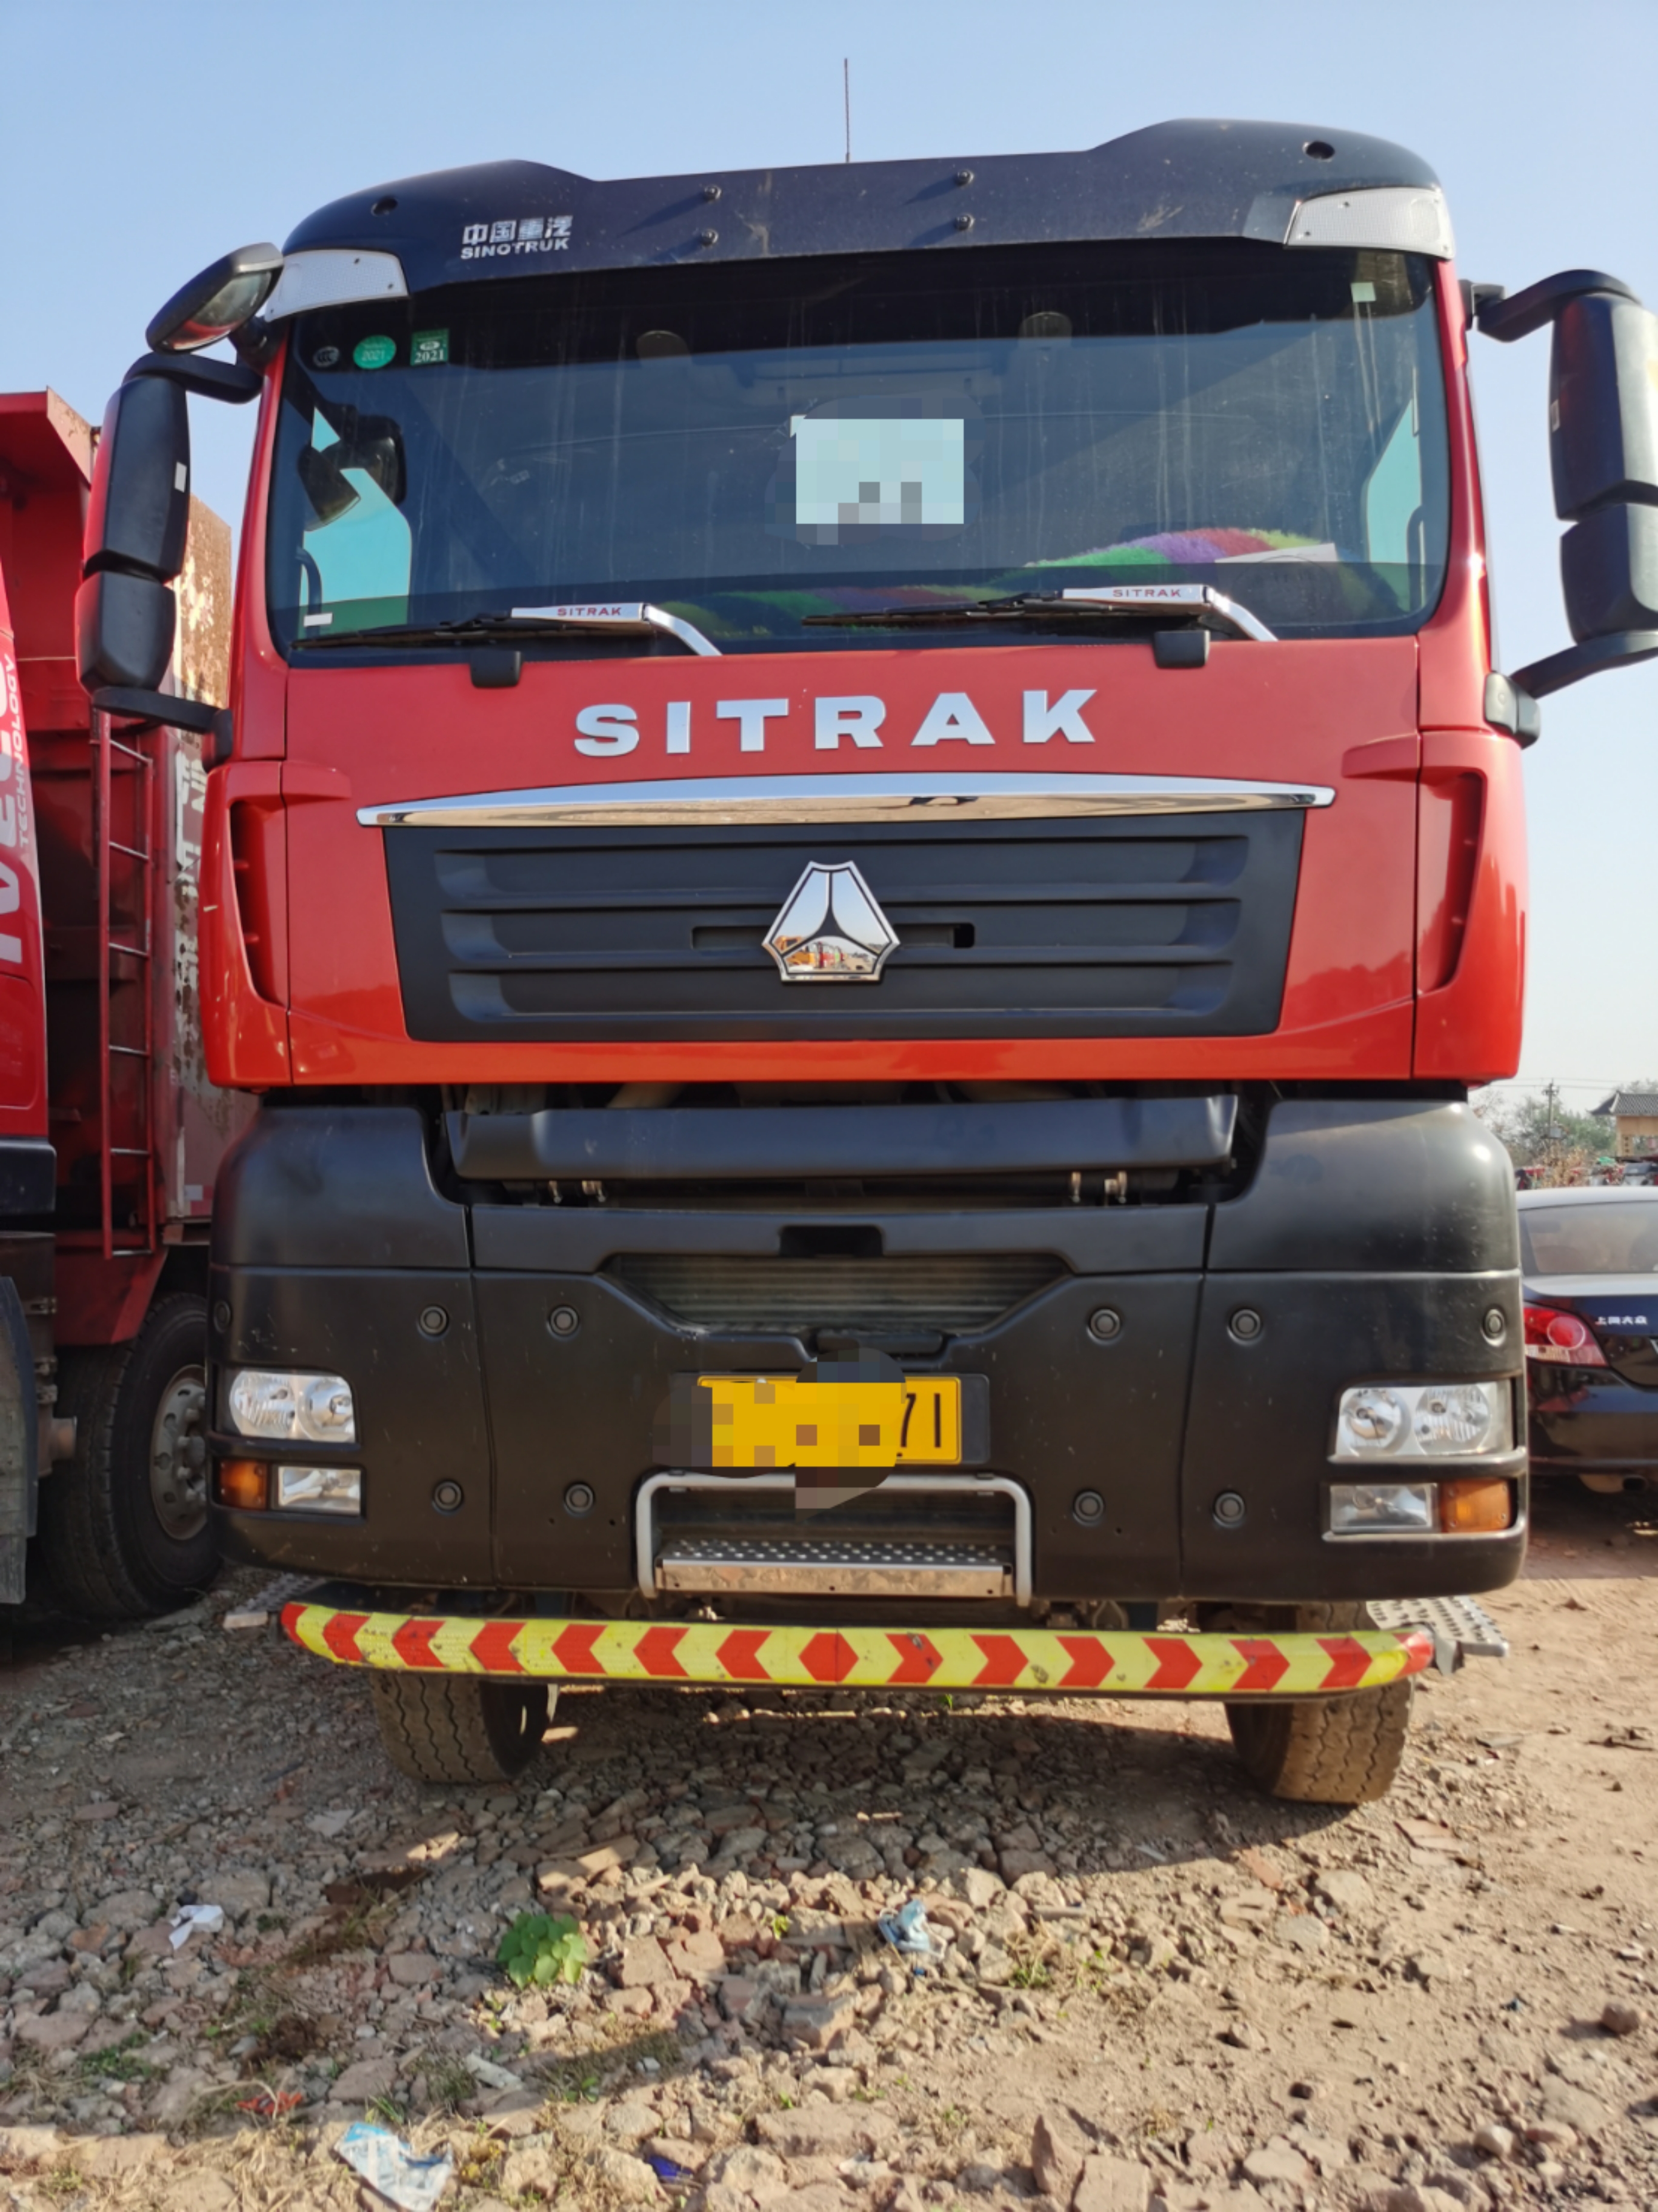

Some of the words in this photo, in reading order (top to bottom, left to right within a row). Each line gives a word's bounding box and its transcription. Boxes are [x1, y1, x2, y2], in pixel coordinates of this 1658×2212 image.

[461, 238, 570, 259] SINOTRUK
[414, 349, 444, 363] 2021
[1113, 588, 1181, 598] SITRAK
[557, 607, 622, 617] SITRAK
[574, 689, 1097, 757] SITRAK
[4, 653, 29, 848] TECHNOLOGY
